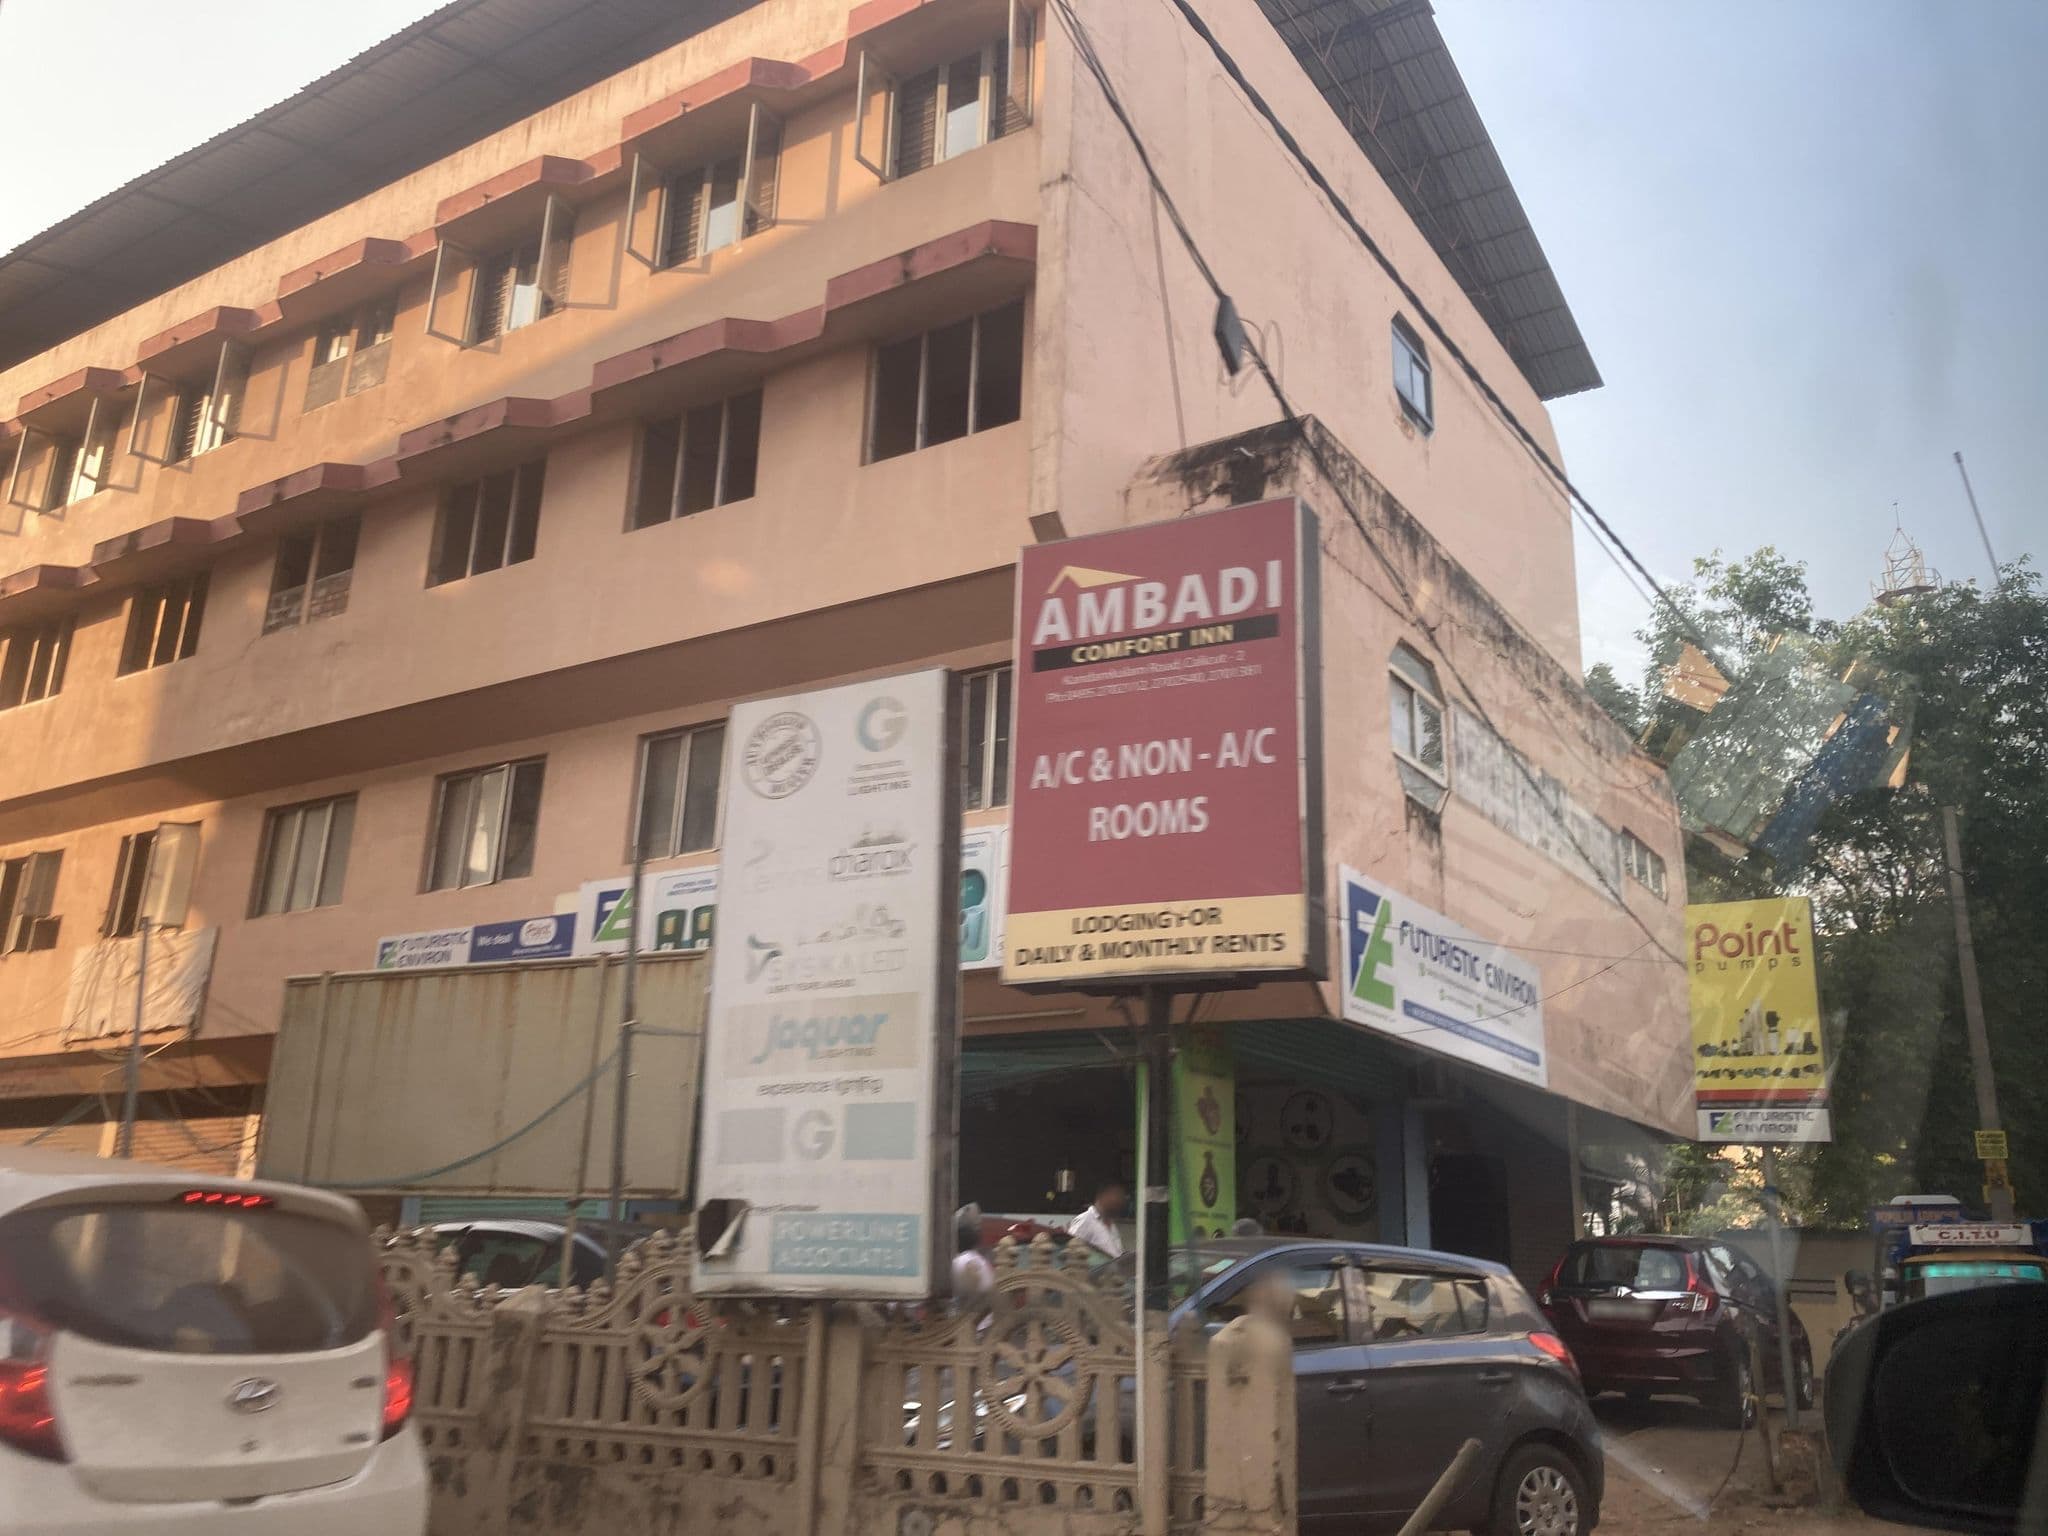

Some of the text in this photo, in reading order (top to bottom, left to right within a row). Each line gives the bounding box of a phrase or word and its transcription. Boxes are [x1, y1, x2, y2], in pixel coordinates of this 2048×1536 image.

[1031, 560, 1282, 646] AMBADI
[1071, 624, 1234, 663] COMFORT INN
[1030, 750, 1086, 790] A/C
[1088, 747, 1114, 783] &
[1118, 737, 1193, 779] NON
[1215, 726, 1278, 769] A/C
[1088, 796, 1210, 842] ROOMS
[1071, 906, 1222, 935] LODGING FOR
[1014, 931, 1288, 967] DAILY & MONTHLY RENTS
[1695, 922, 1801, 961] Point
[1696, 957, 1801, 974] pumps
